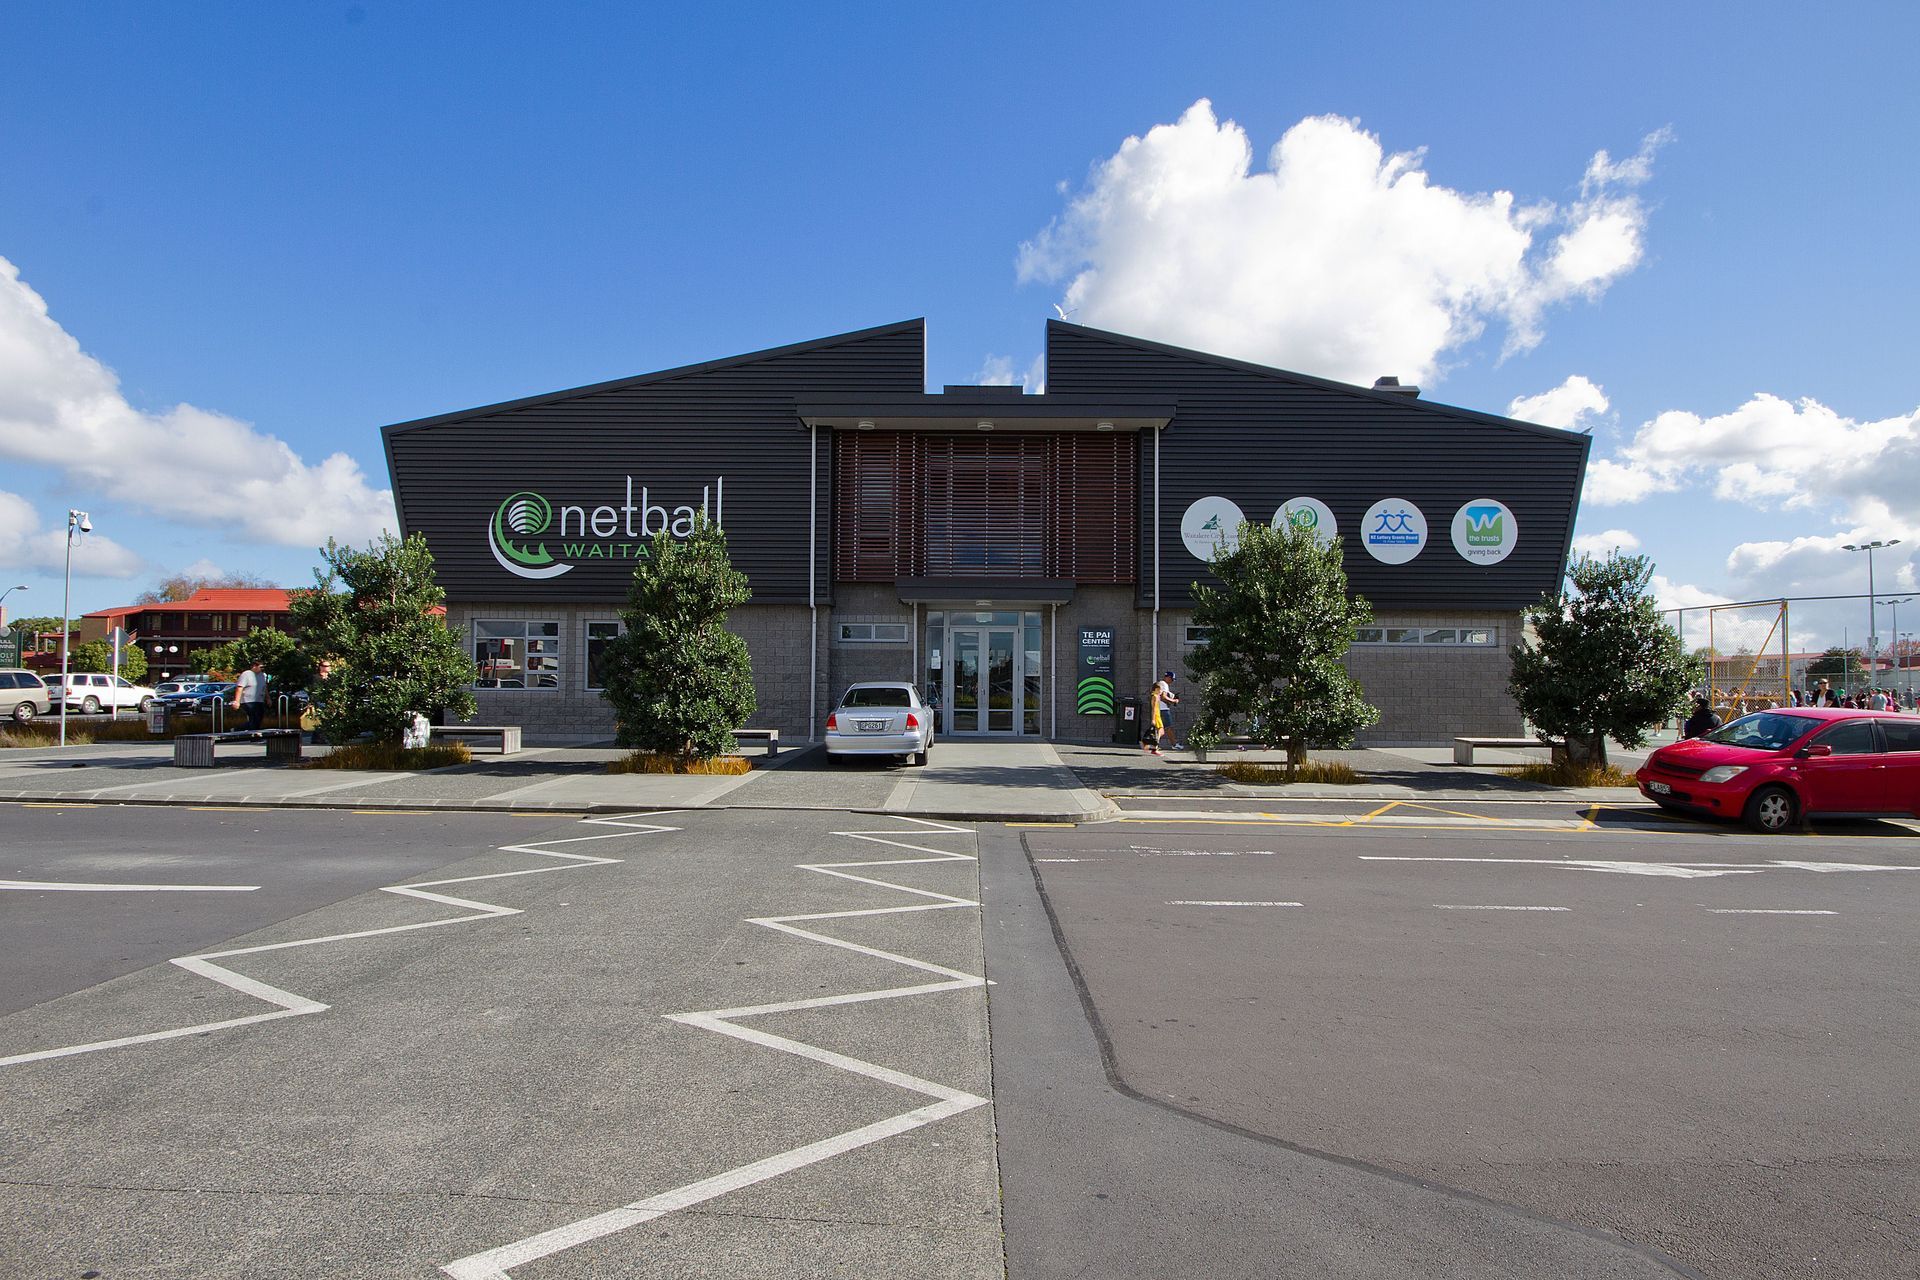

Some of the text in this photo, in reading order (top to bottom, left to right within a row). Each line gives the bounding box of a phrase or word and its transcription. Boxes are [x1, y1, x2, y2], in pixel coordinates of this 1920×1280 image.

[561, 475, 723, 537] netball
[563, 544, 721, 558] WAITA
[0, 652, 15, 660] OLF
